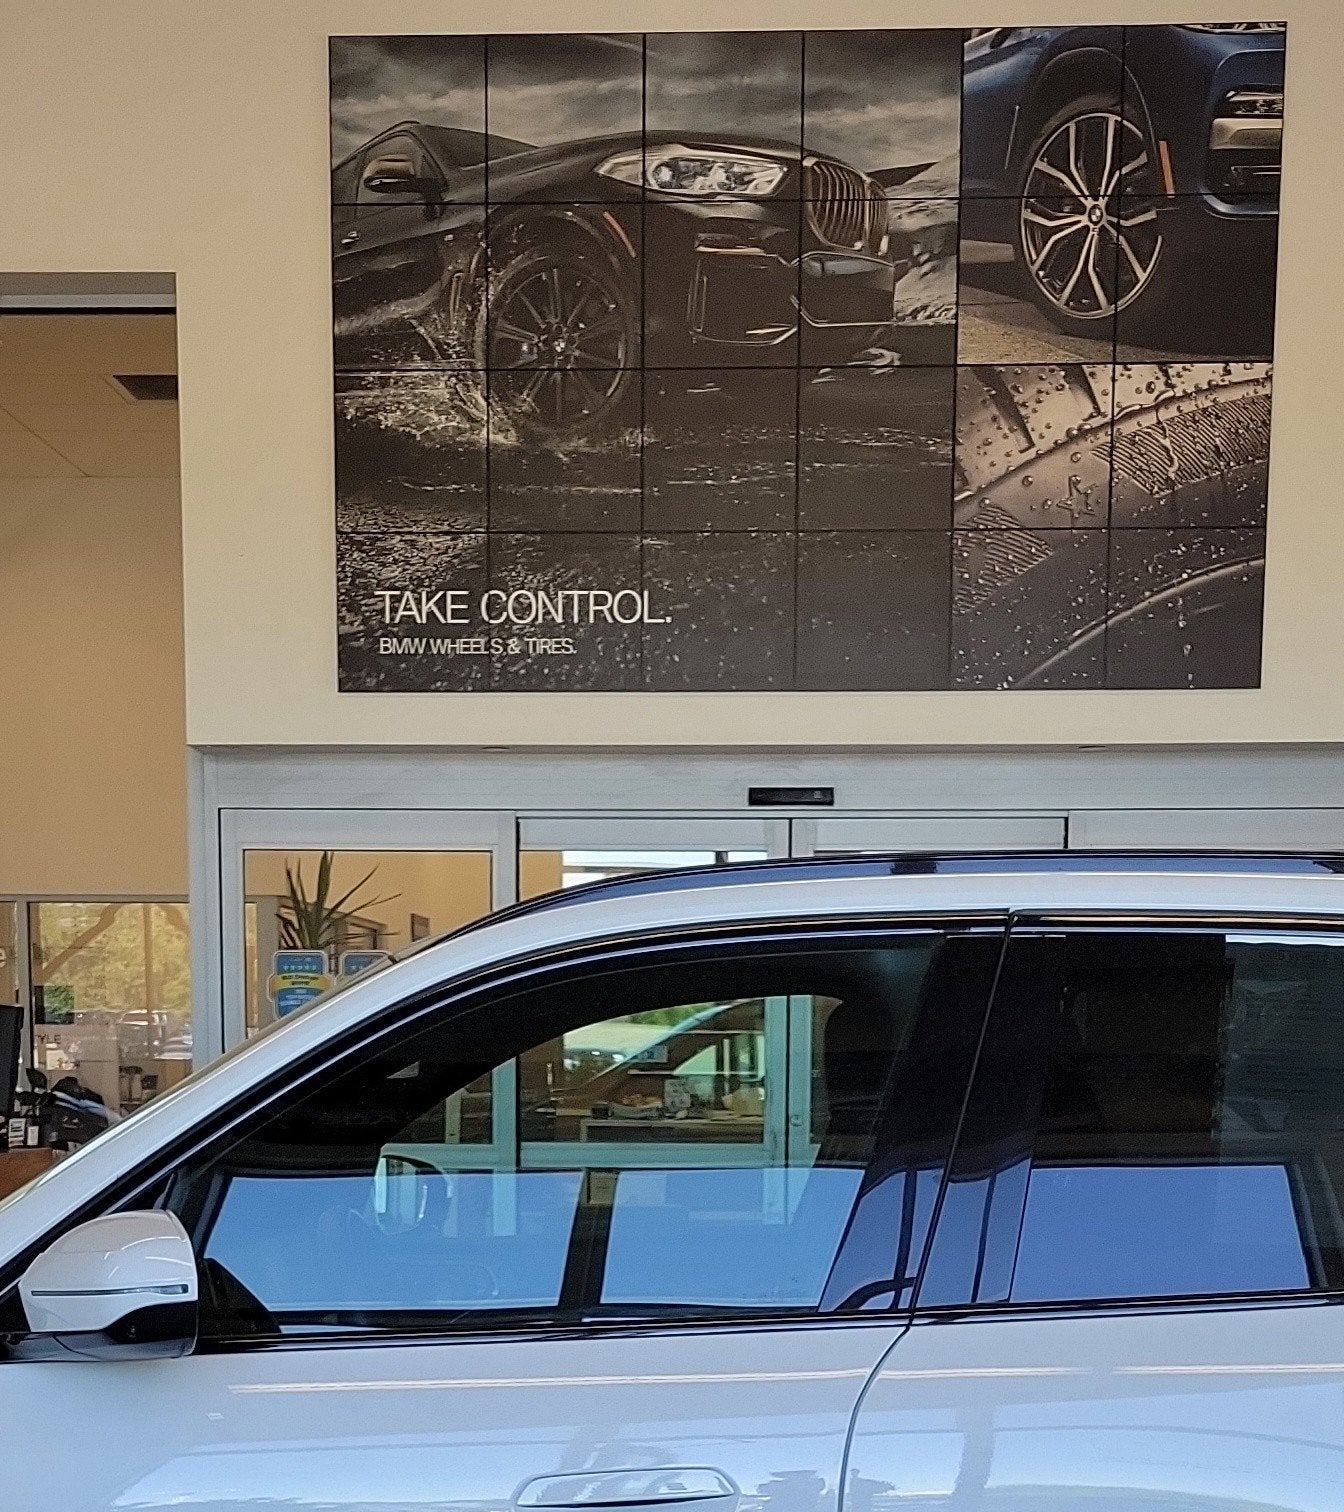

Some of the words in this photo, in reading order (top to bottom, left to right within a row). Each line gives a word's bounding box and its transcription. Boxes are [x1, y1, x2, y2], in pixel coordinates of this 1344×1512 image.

[373, 590, 470, 624] TAKE
[480, 589, 672, 624] CONTROL.
[379, 637, 427, 655] BMW
[429, 637, 504, 655] WHEELS
[507, 638, 521, 654] &
[524, 637, 577, 654] TIRES.
